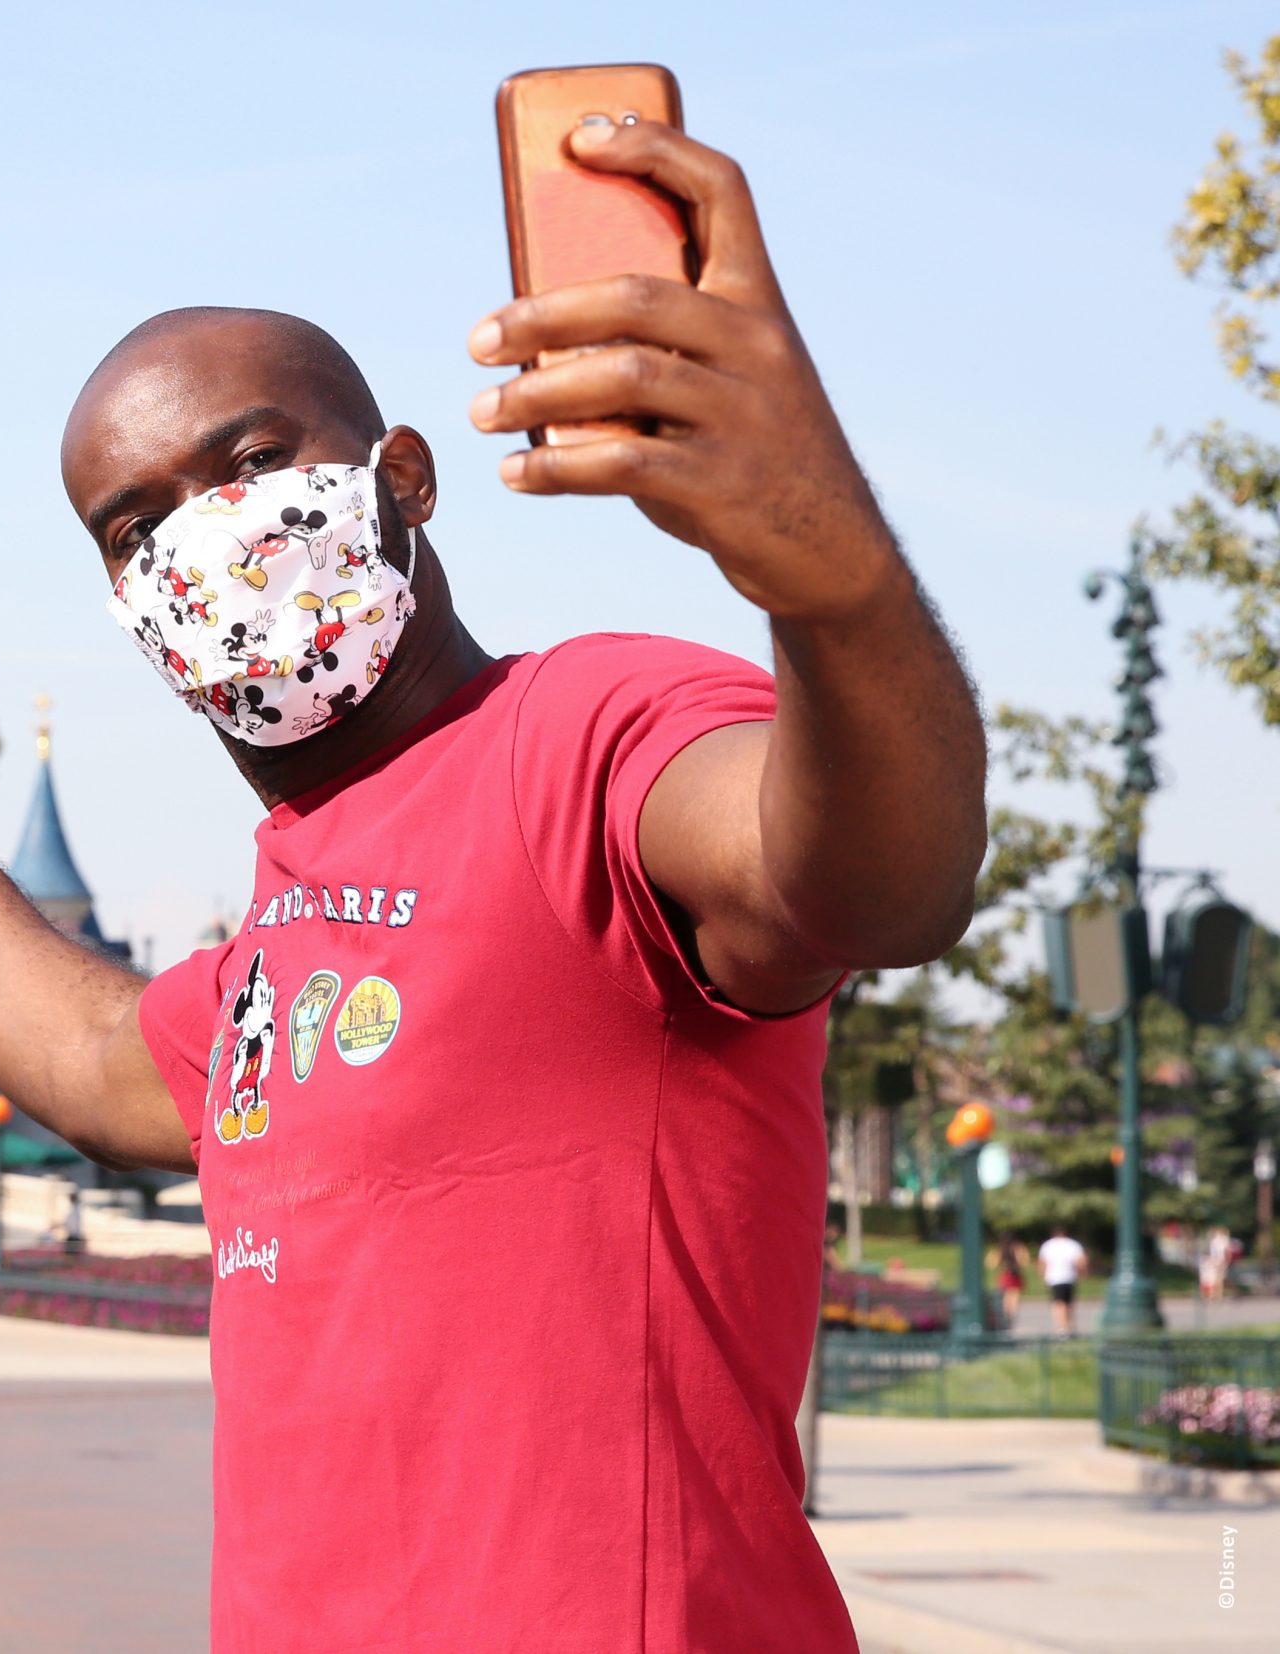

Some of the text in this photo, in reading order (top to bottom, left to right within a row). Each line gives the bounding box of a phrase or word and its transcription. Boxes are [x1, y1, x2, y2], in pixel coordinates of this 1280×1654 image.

[249, 882, 418, 934] AND ARIS
[340, 1022, 393, 1041] HOLLYWOOD
[351, 1035, 380, 1049] TOWER
[293, 1148, 319, 1182] sight
[235, 1226, 279, 1284] Disney
